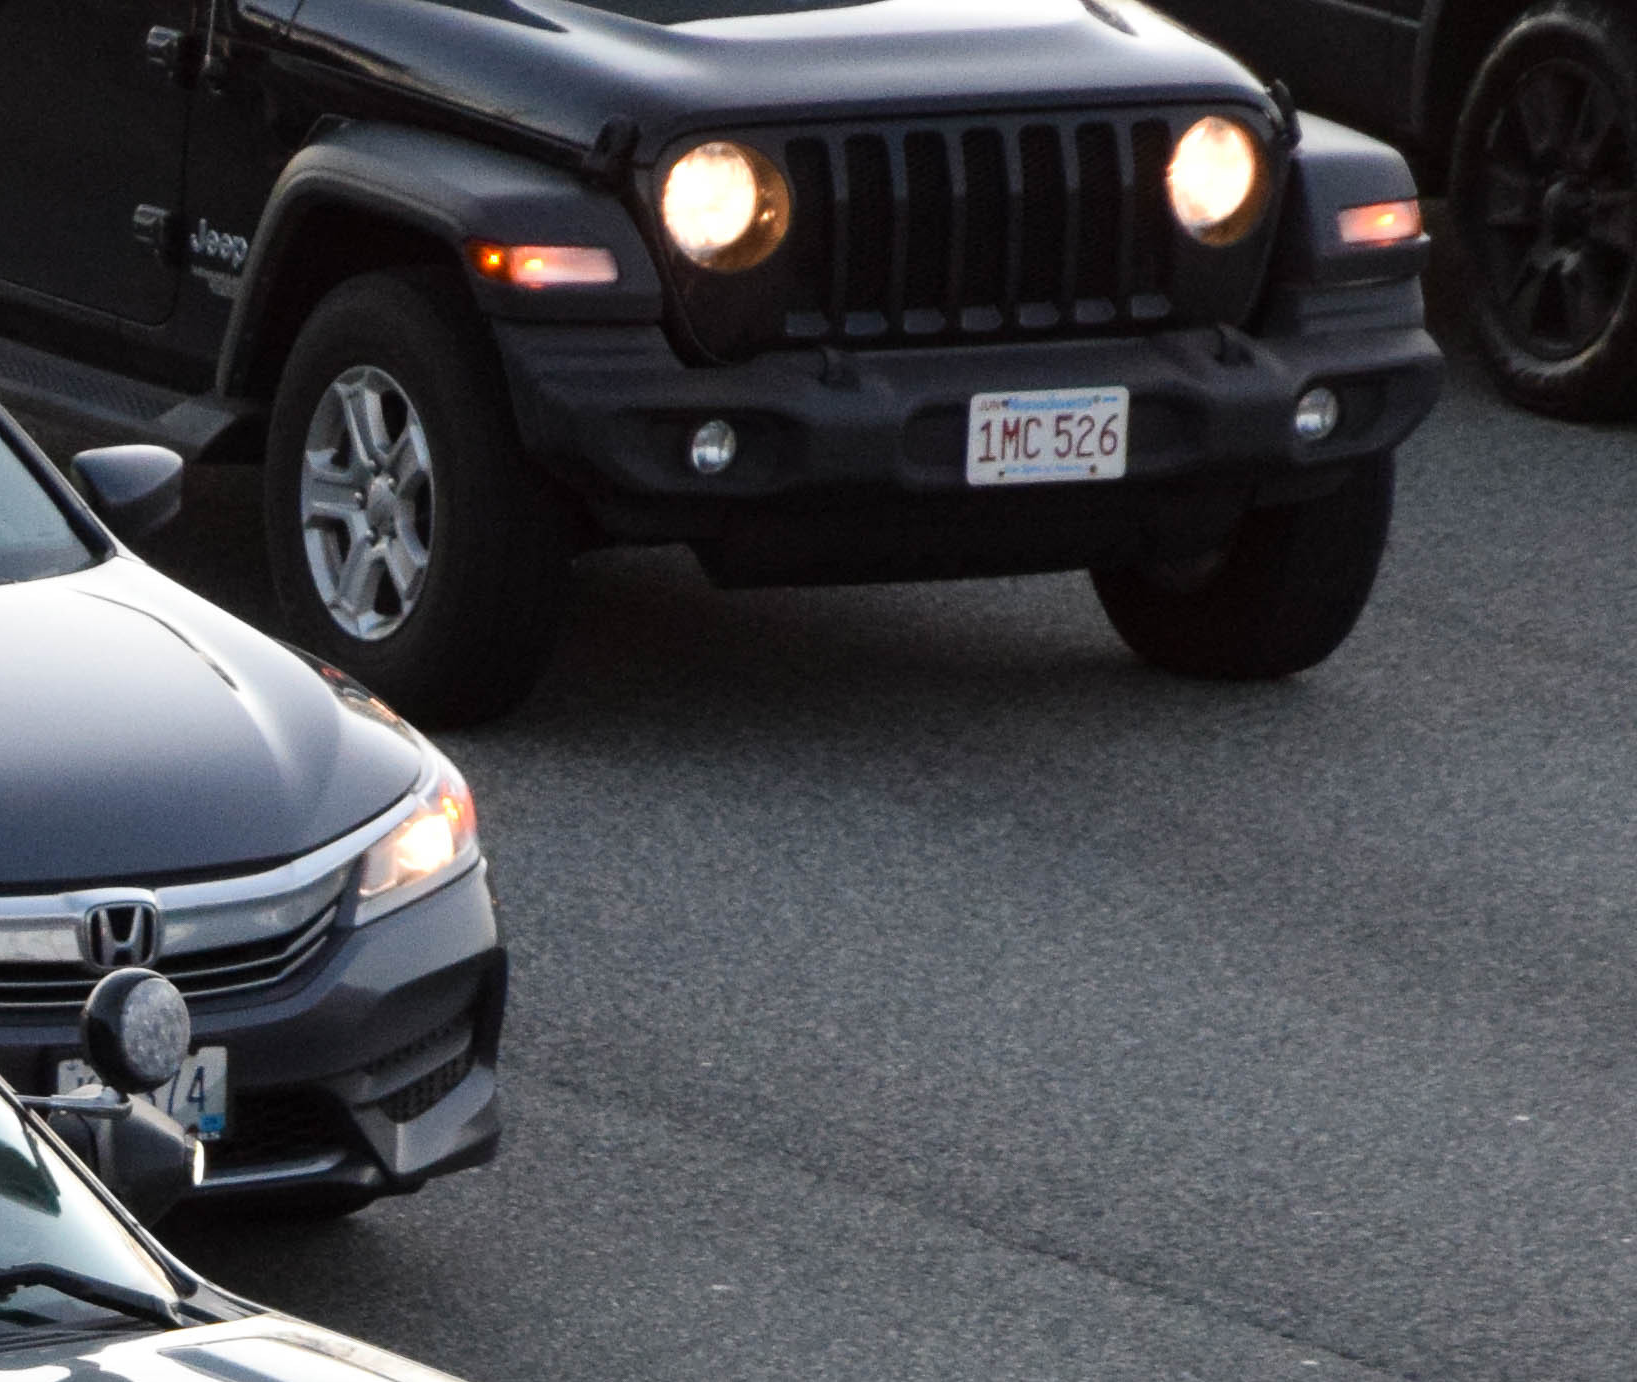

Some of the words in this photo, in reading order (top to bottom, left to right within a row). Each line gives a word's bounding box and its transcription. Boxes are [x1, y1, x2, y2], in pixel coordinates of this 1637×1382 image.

[189, 217, 248, 269] Jeep
[978, 415, 1042, 463] 1MC
[1054, 412, 1119, 458] 526
